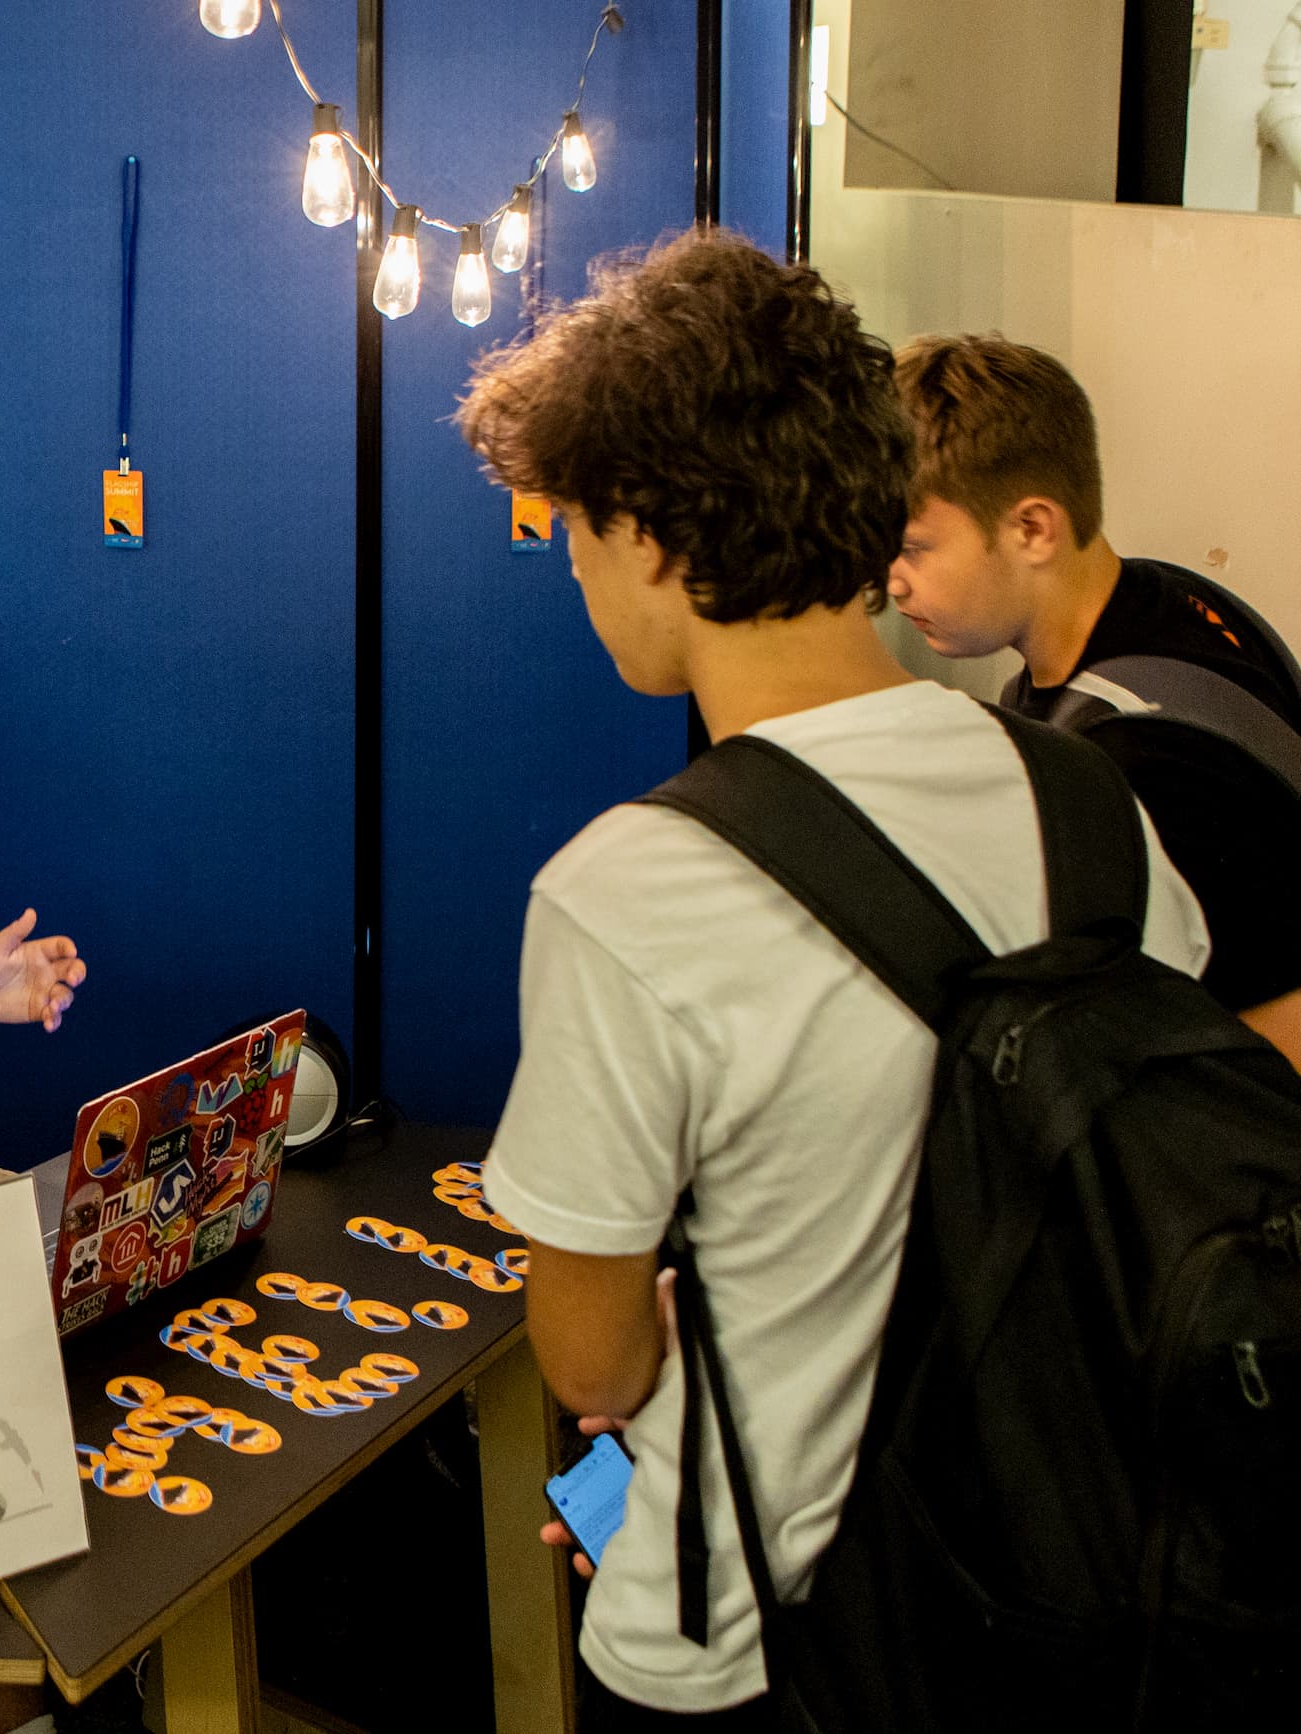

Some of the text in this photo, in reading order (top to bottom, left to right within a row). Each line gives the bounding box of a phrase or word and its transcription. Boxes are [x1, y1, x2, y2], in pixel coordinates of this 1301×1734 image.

[269, 1087, 284, 1119] h
[150, 1141, 171, 1158] Hack
[101, 1182, 152, 1228] MLH
